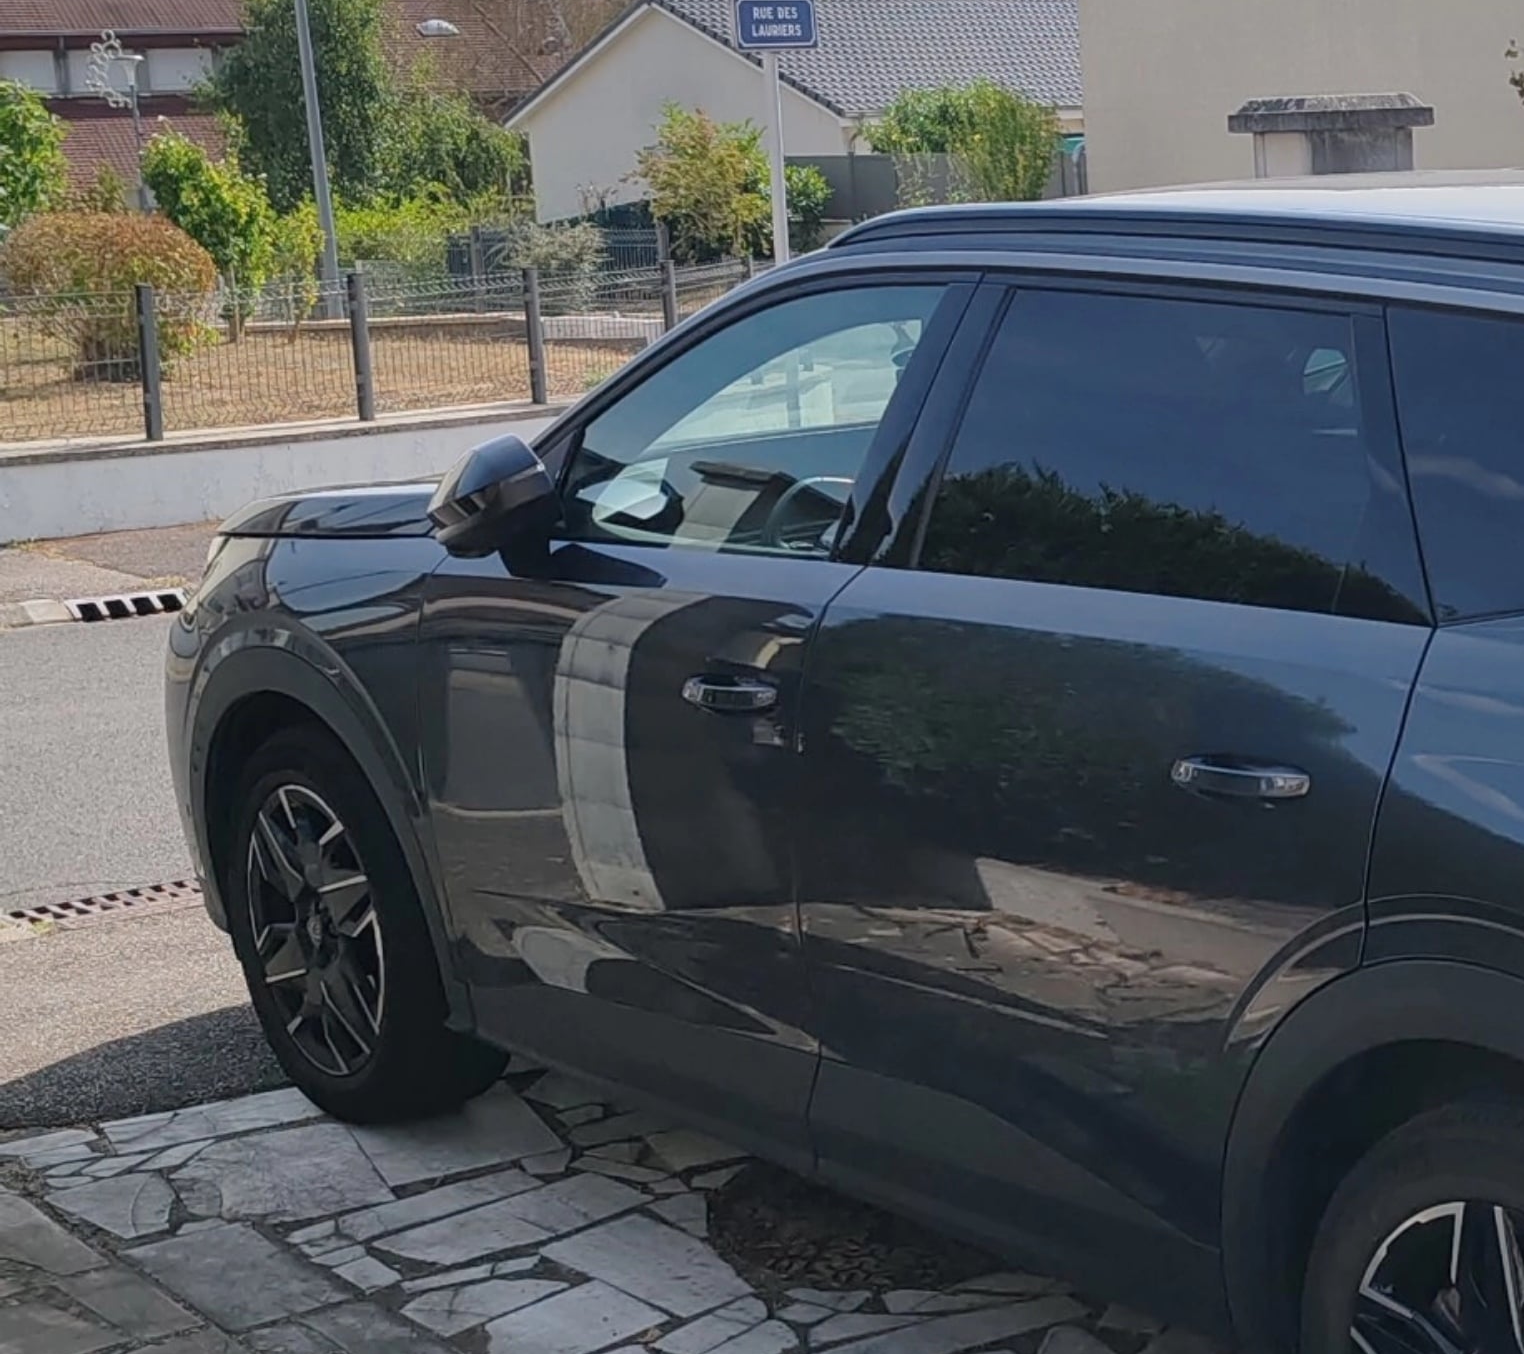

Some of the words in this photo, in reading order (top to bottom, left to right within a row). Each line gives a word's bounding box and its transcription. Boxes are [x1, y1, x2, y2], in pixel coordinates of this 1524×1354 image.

[752, 6, 774, 20] RUE
[777, 6, 798, 19] DES
[751, 24, 802, 37] LAURIERS
